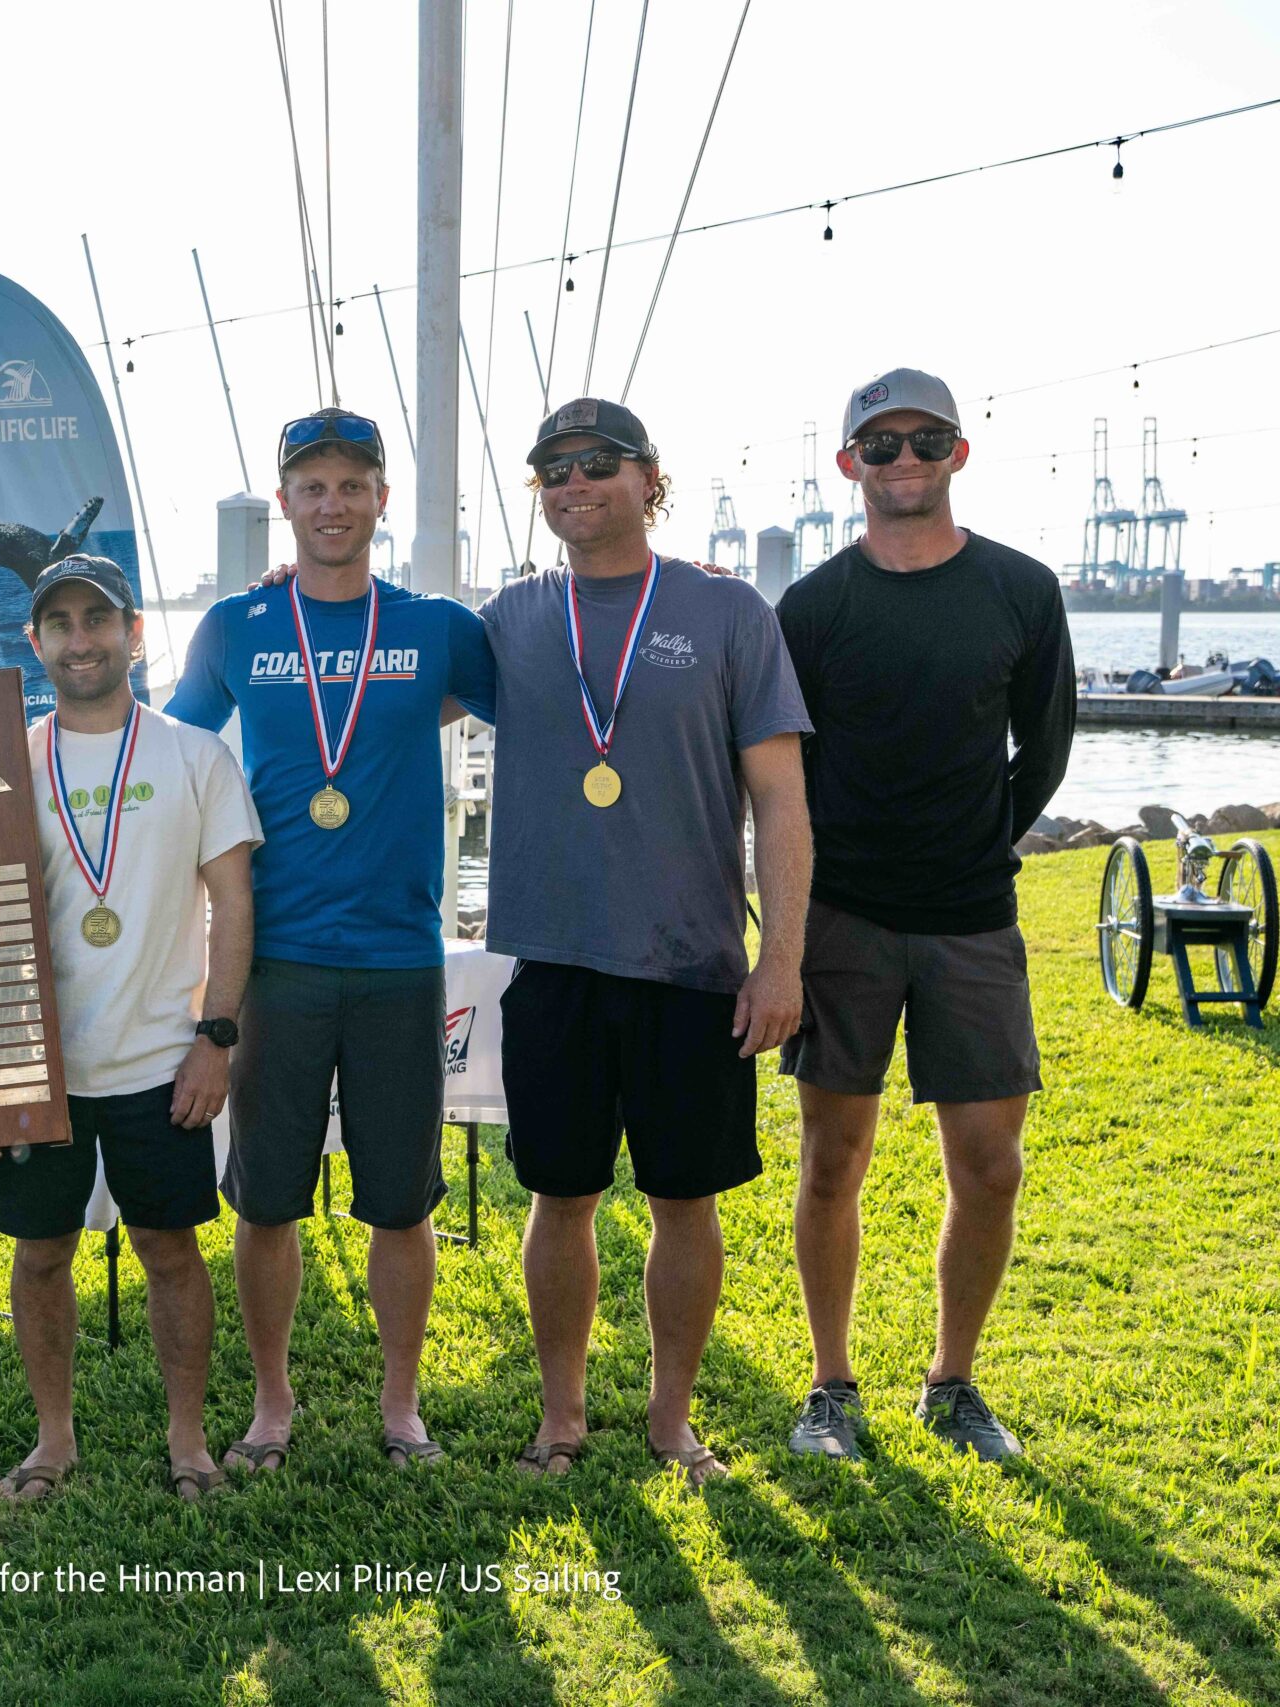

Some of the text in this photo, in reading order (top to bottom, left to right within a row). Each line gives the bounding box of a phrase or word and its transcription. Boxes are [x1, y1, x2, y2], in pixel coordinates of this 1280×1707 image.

[40, 416, 79, 440] LIFE
[648, 631, 694, 656] Wally's
[336, 649, 419, 674] GARD
[649, 653, 686, 665] WIENERS
